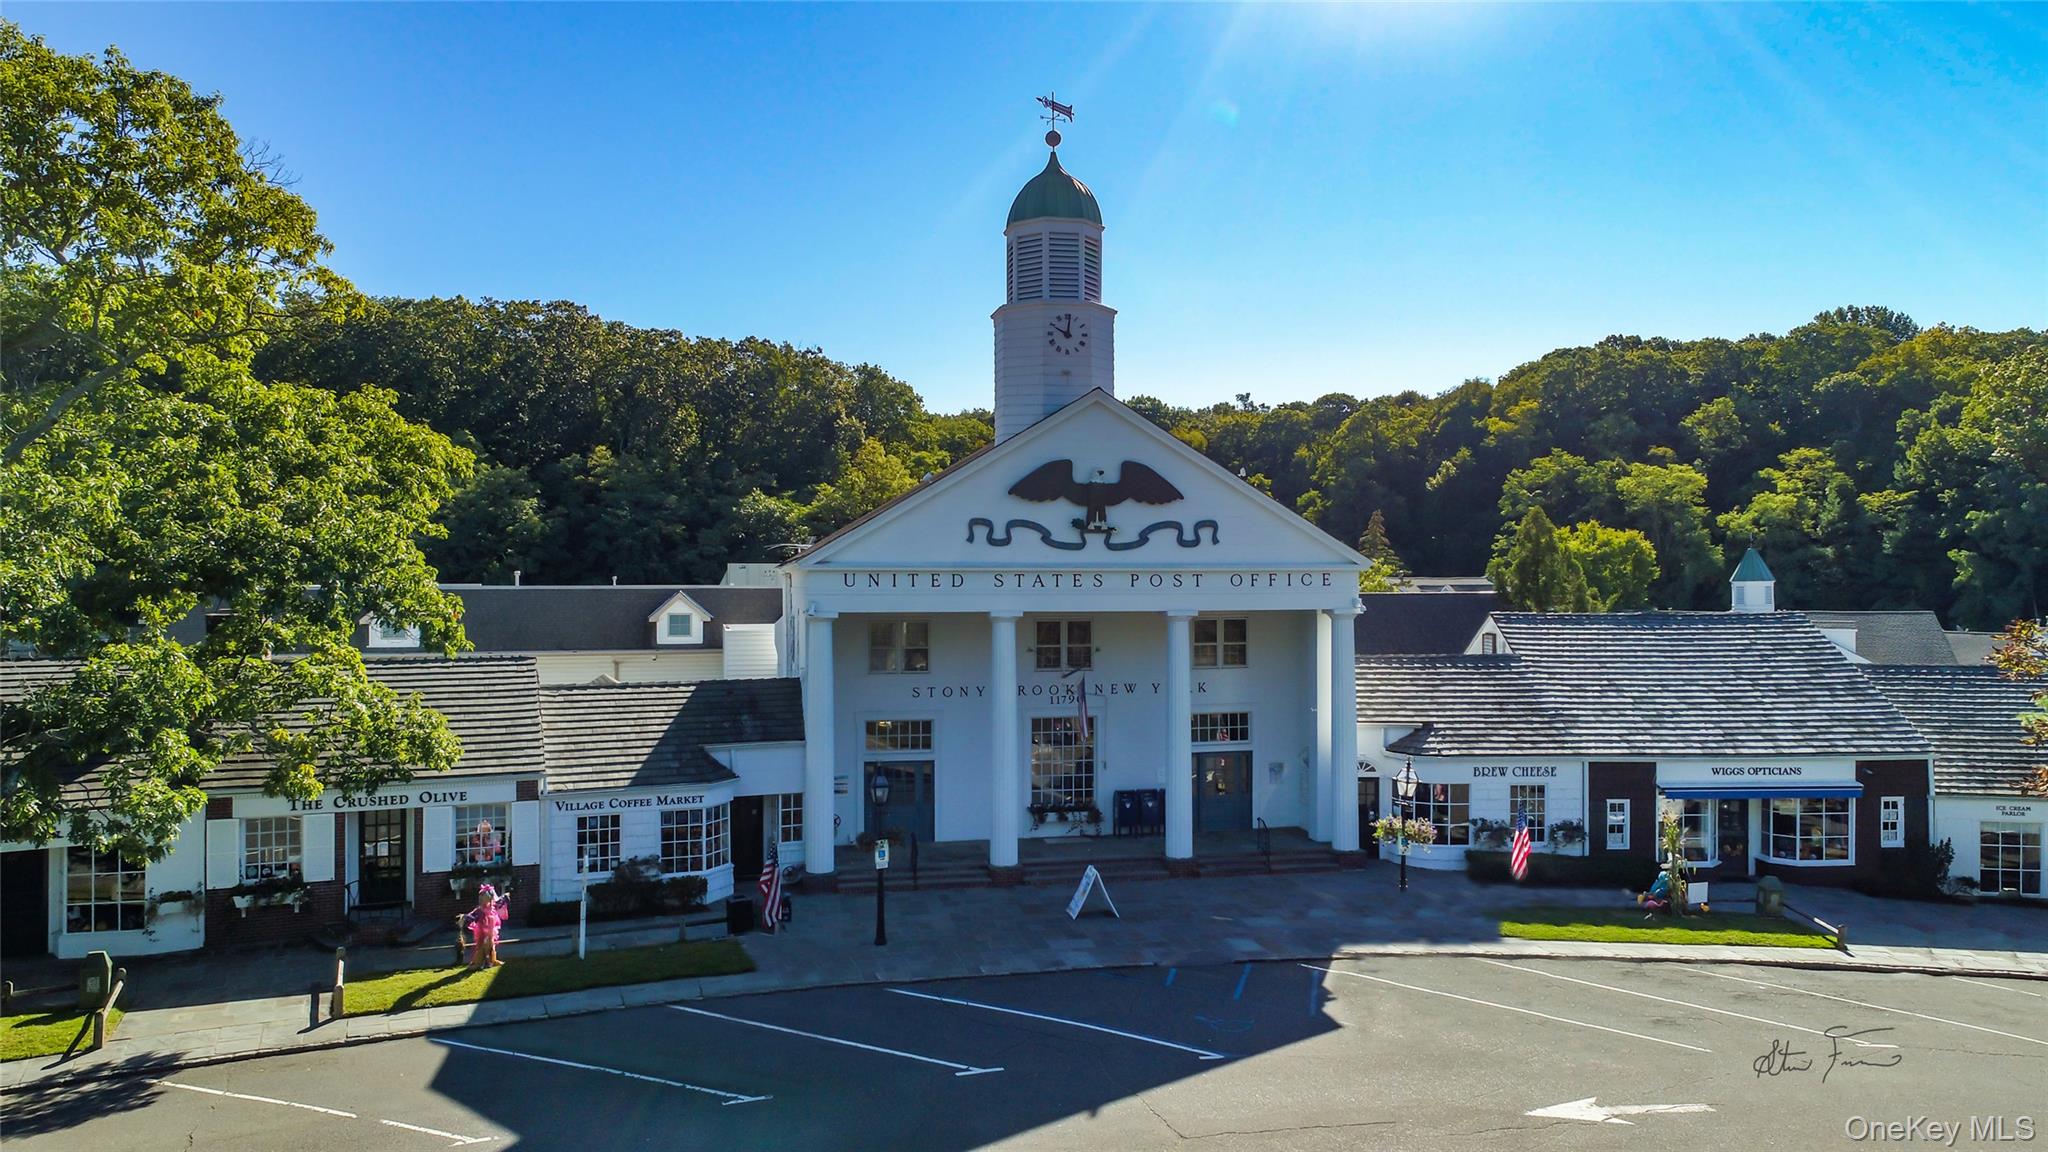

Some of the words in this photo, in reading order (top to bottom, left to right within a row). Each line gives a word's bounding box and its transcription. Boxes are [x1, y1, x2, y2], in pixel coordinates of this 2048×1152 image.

[843, 573, 964, 588] UNITED
[994, 573, 1103, 588] STATES
[1130, 573, 1204, 587] POST
[1230, 572, 1332, 587] OFFICE
[912, 686, 986, 698] STONY
[1017, 684, 1074, 696] ROOK
[1094, 682, 1137, 695] NEW
[1151, 681, 1207, 694] YK
[1473, 766, 1508, 777] BREW
[1512, 766, 1557, 777] CHEESE
[1711, 767, 1745, 776] WIGGS
[1747, 767, 1802, 776] OPTICIANS
[287, 798, 323, 811] THE
[333, 794, 409, 808] CRUSHED
[419, 791, 468, 803] OLIVE
[555, 801, 604, 812] VILLAGE
[609, 798, 652, 809] COFFEE
[656, 795, 705, 806] MARKET
